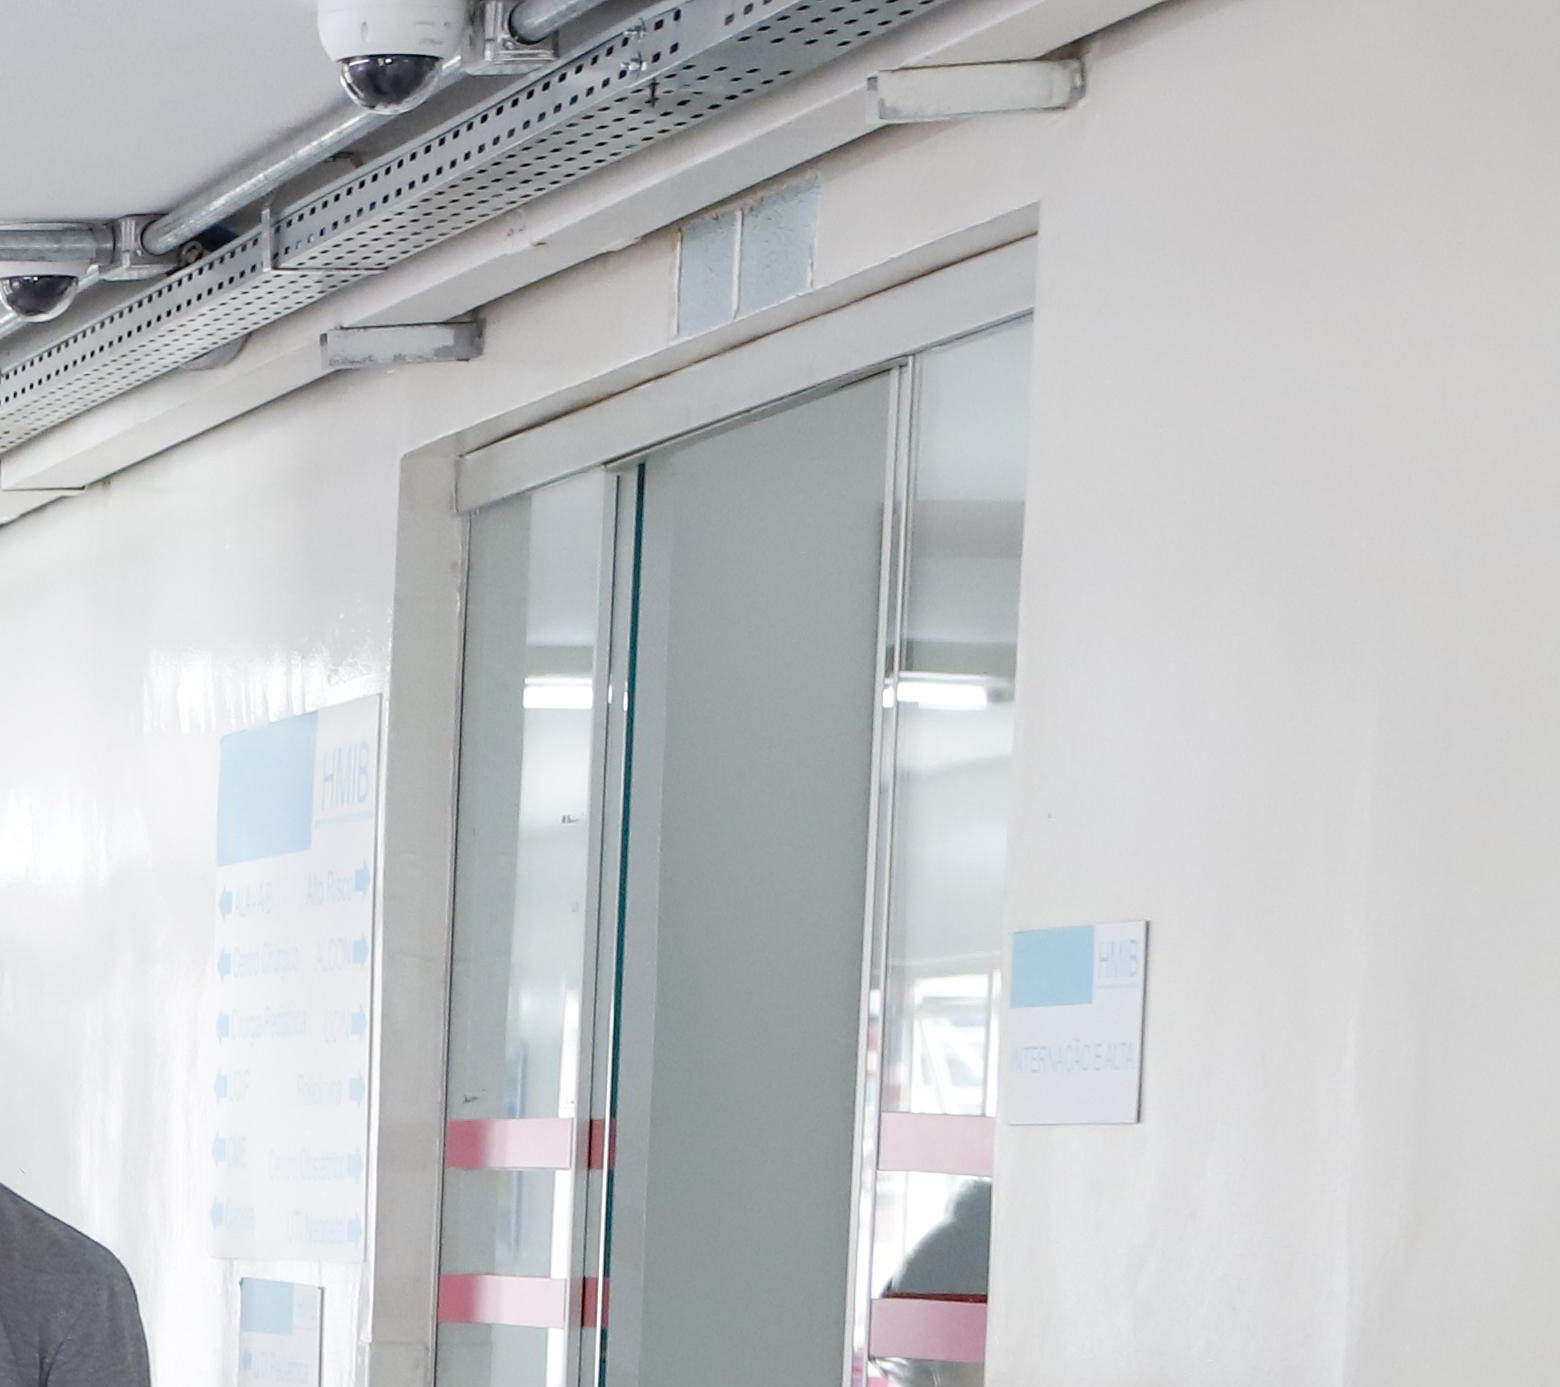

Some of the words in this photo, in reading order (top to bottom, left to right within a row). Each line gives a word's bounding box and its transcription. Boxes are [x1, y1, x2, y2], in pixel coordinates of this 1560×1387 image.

[321, 741, 370, 810] HMIB
[1009, 1039, 1091, 1080] INTERNAÇÃO
[1094, 1043, 1103, 1071] E
